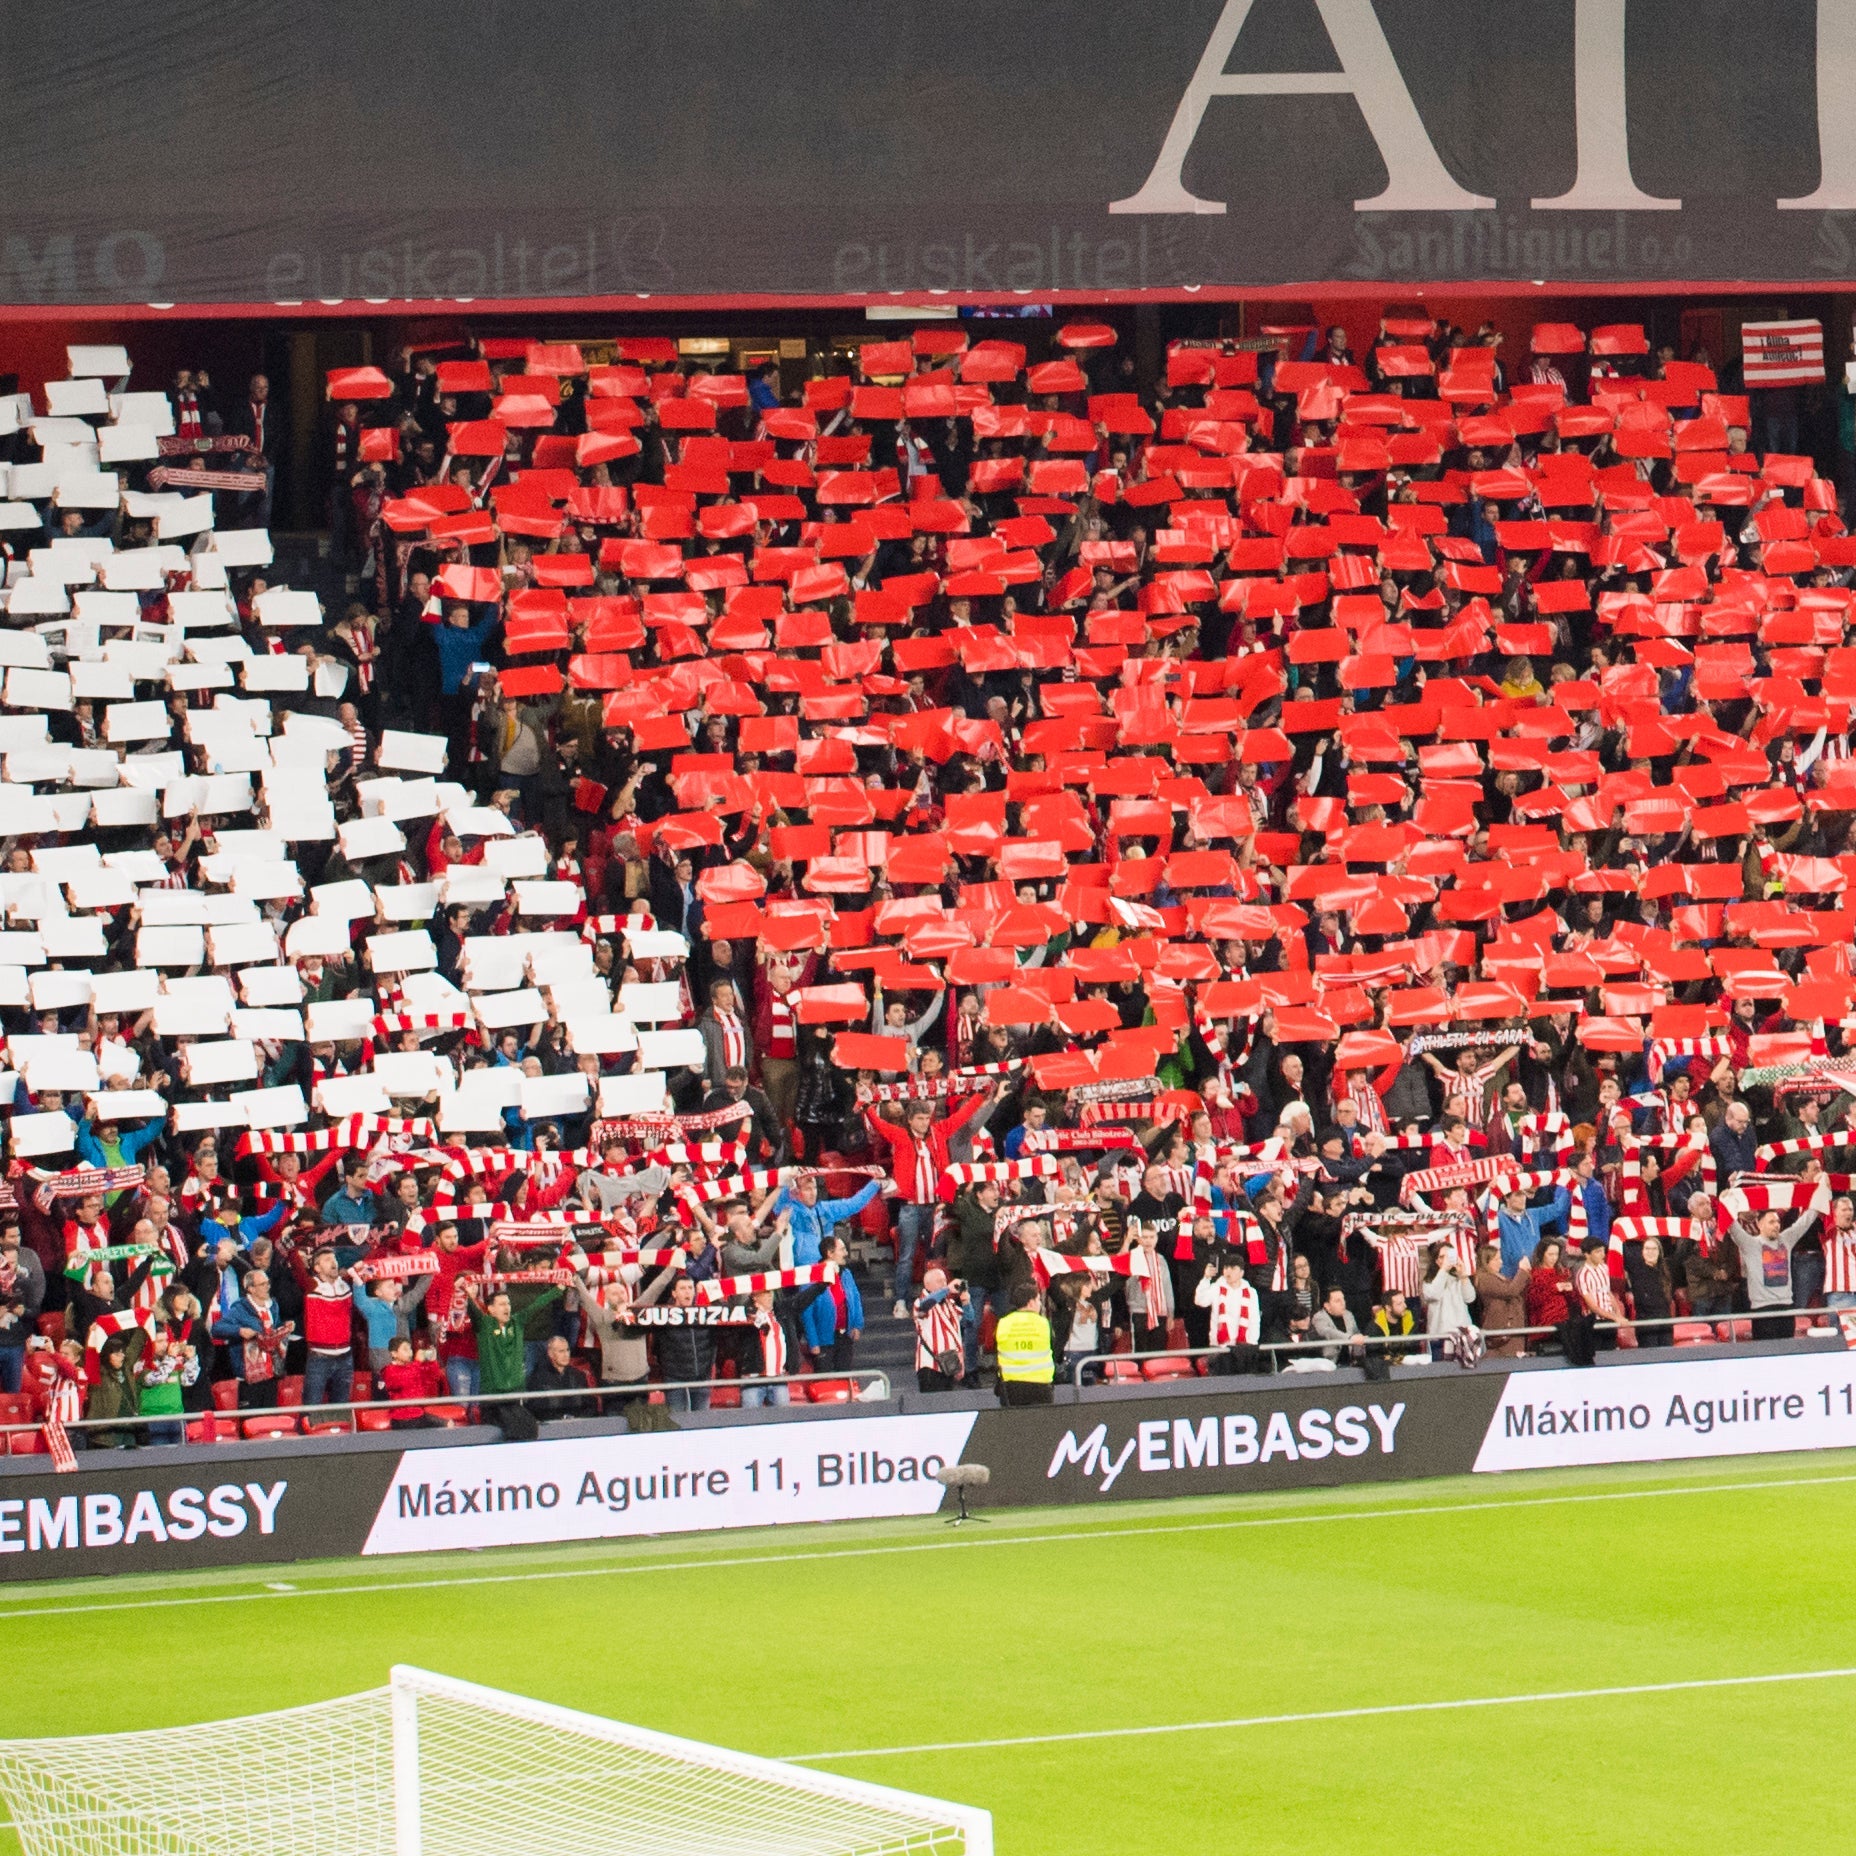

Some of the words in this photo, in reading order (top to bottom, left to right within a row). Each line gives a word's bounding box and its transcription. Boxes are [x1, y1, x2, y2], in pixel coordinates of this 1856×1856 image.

[638, 1305, 747, 1325] JUSTIZIA
[1505, 1402, 1651, 1438] Máximo
[1665, 1394, 1804, 1434] Aguirre
[399, 1481, 560, 1518] Máximo
[577, 1470, 729, 1512] Aguirre
[745, 1458, 800, 1495] 11,
[817, 1451, 944, 1487] Bilbao
